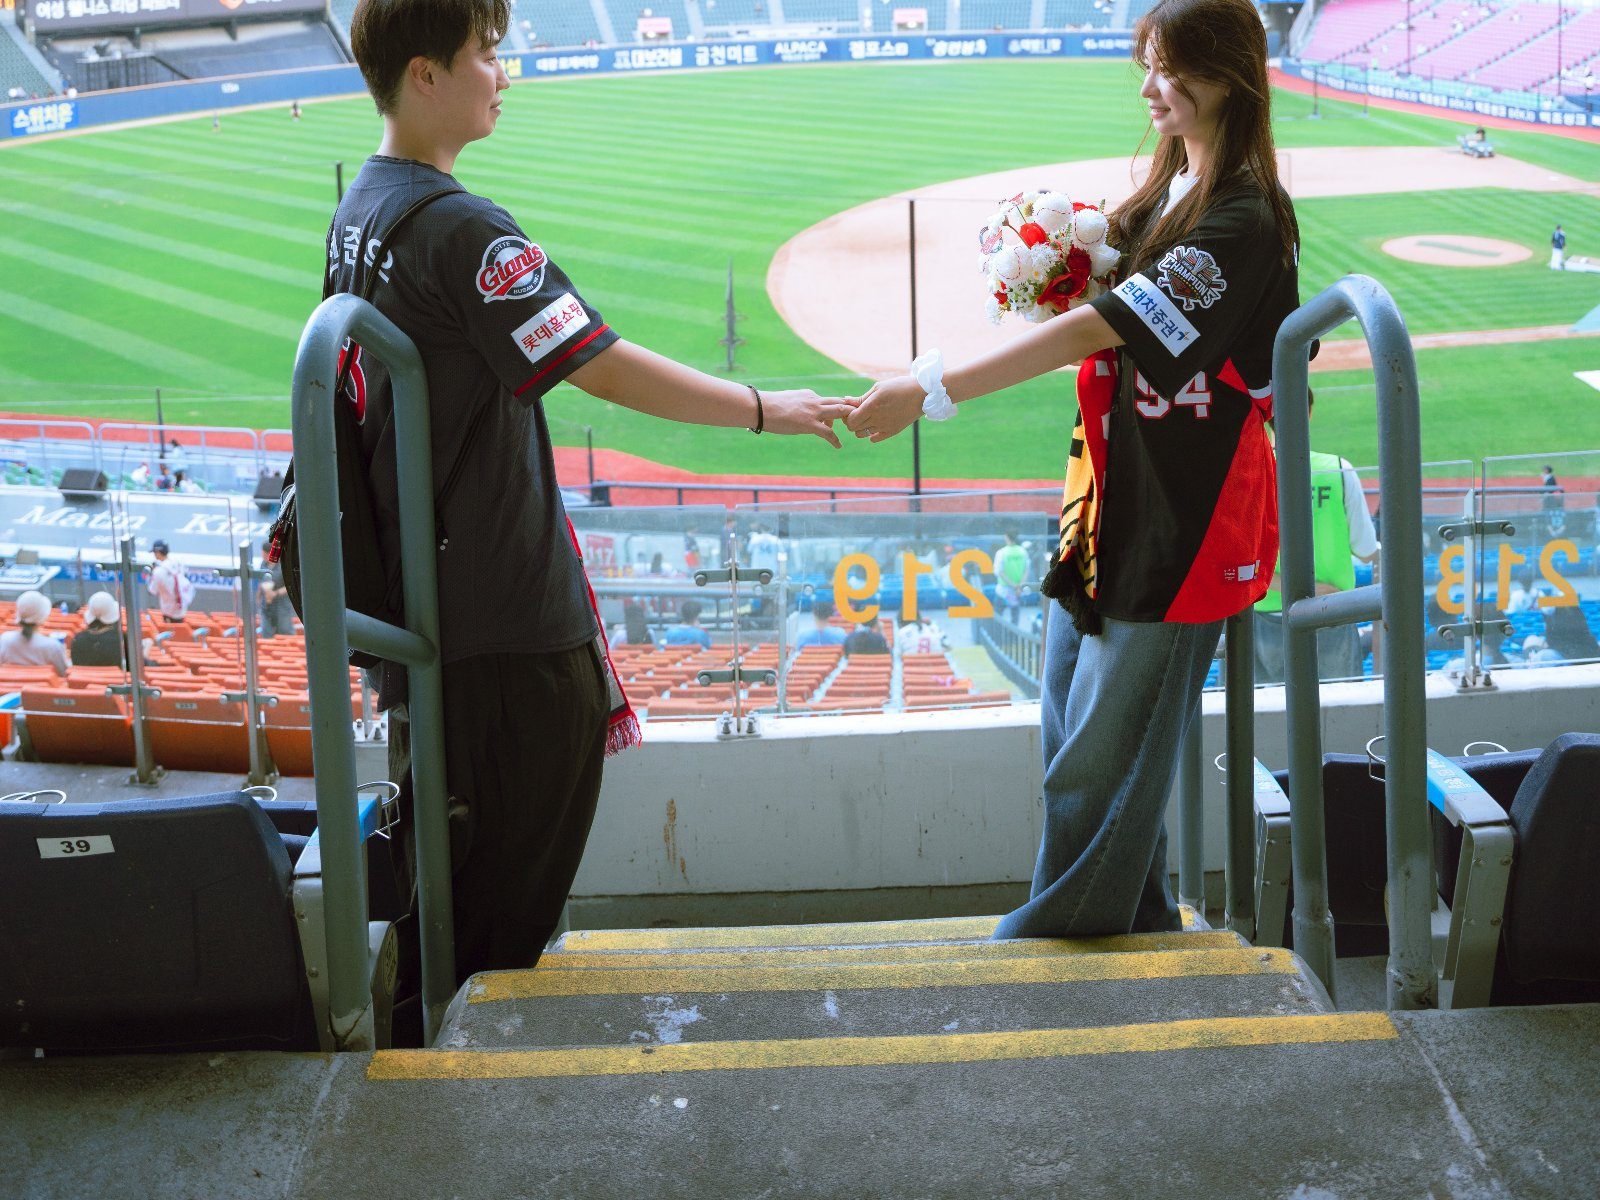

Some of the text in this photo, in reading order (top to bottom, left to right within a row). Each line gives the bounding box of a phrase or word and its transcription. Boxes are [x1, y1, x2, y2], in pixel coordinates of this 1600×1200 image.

[480, 245, 543, 292] Giants
[491, 240, 511, 256] LOTTE
[1160, 255, 1219, 306] CHAMPIONS
[521, 302, 583, 353] 롯데홈쇼핑
[1121, 280, 1178, 338] 현대차증권
[60, 840, 91, 854] 39
